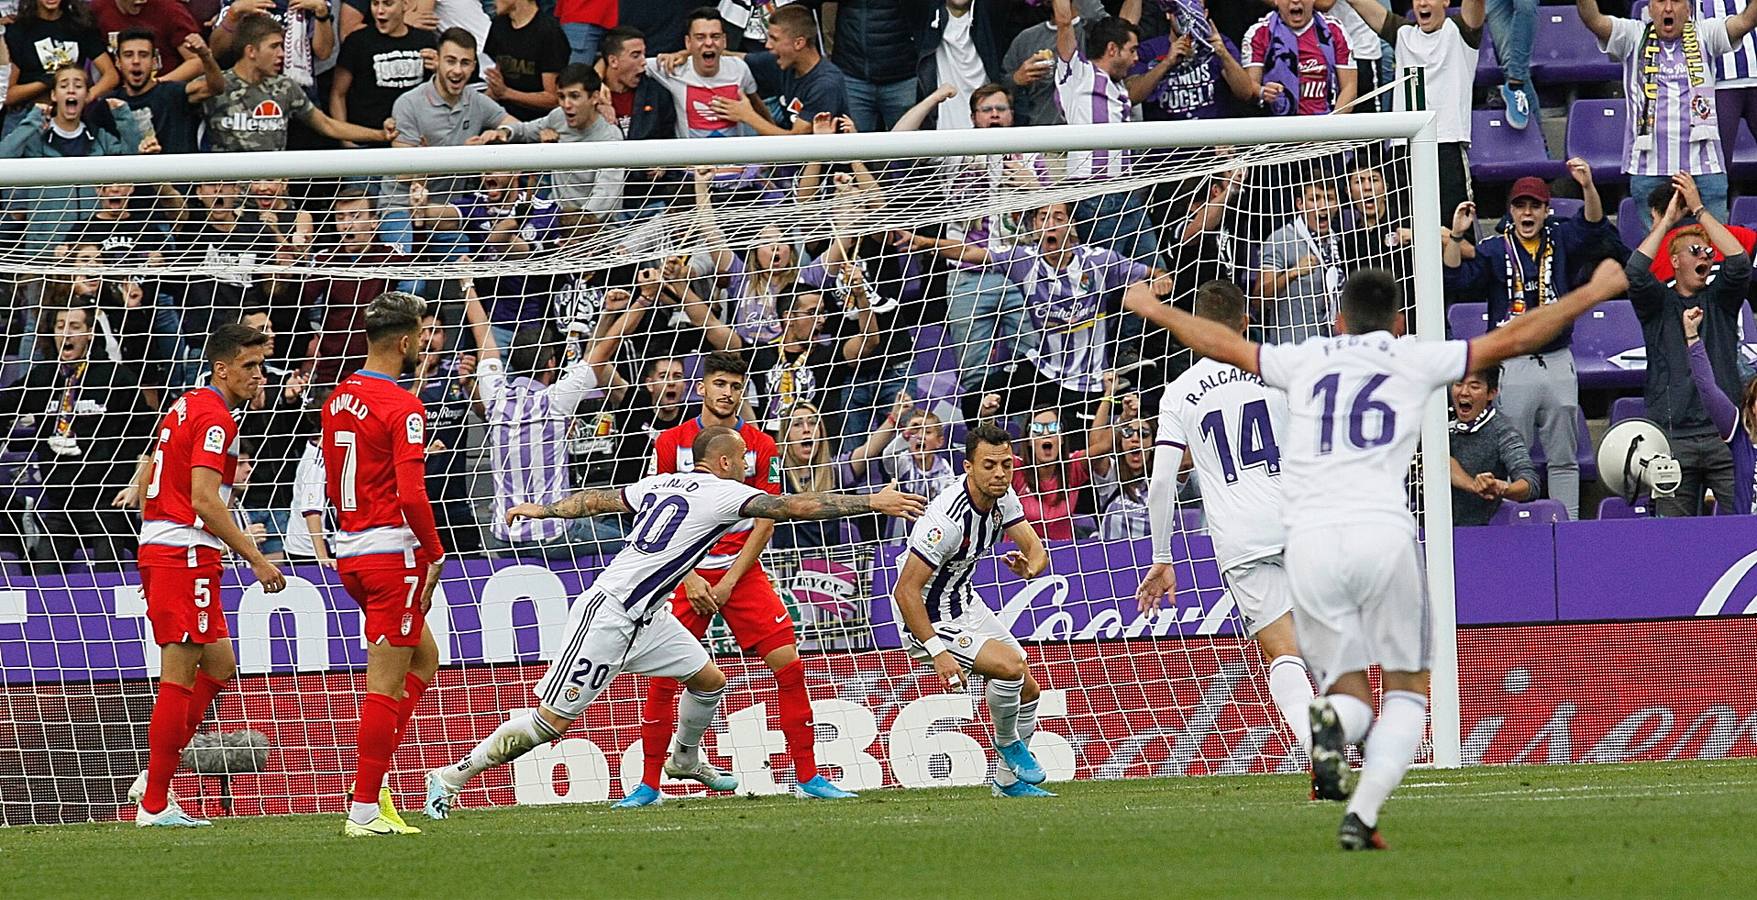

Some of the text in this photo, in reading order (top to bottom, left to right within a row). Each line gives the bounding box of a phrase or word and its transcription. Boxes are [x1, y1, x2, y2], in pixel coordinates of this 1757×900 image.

[1682, 22, 1705, 87] ORRILLA
[221, 112, 285, 131] ellesse
[102, 236, 134, 250] REAL
[1311, 373, 1396, 455] 16
[1198, 398, 1282, 487] 14
[334, 430, 358, 512] 7
[193, 577, 211, 609] 5
[404, 575, 418, 609] 7
[571, 657, 610, 690] 20
